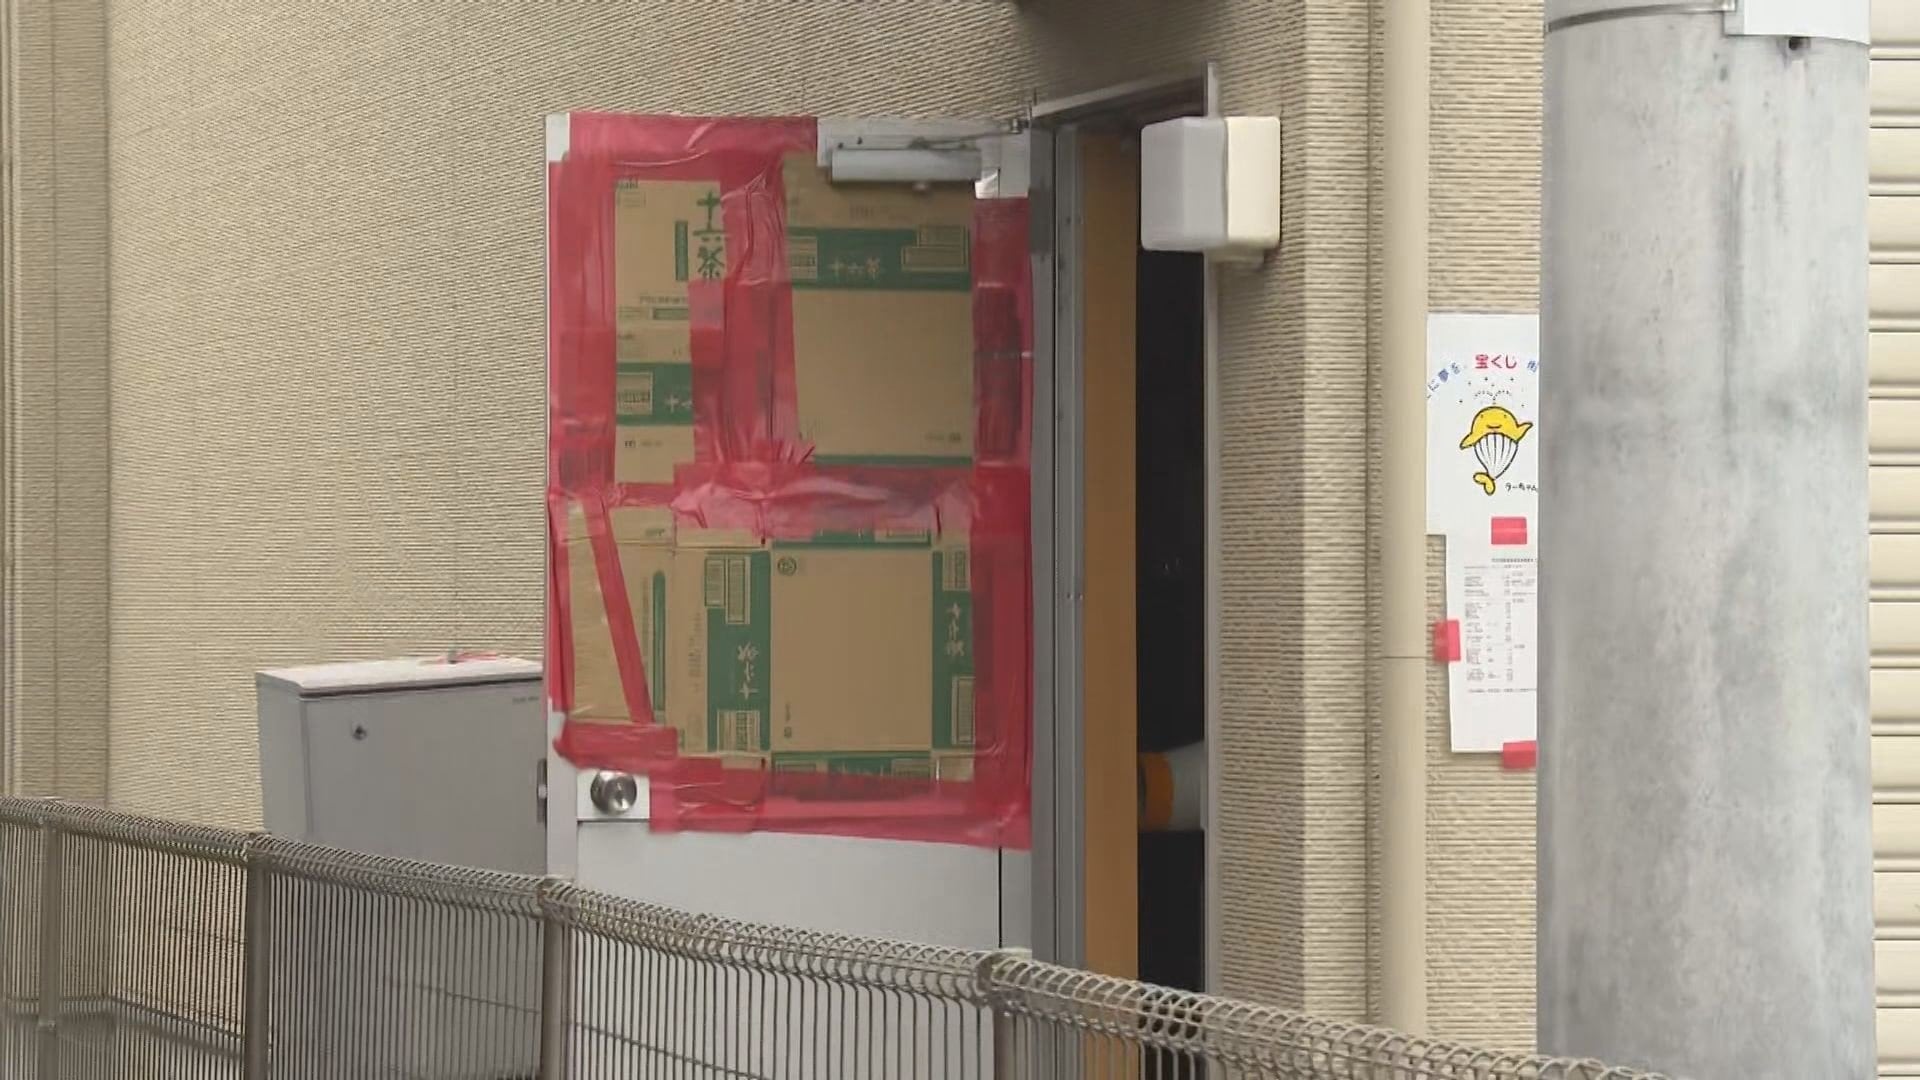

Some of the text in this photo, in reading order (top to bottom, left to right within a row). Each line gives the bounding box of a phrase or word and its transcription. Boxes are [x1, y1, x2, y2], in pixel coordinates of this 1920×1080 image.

[692, 189, 726, 280] 十六茶
[1475, 354, 1518, 370] 宝くじ
